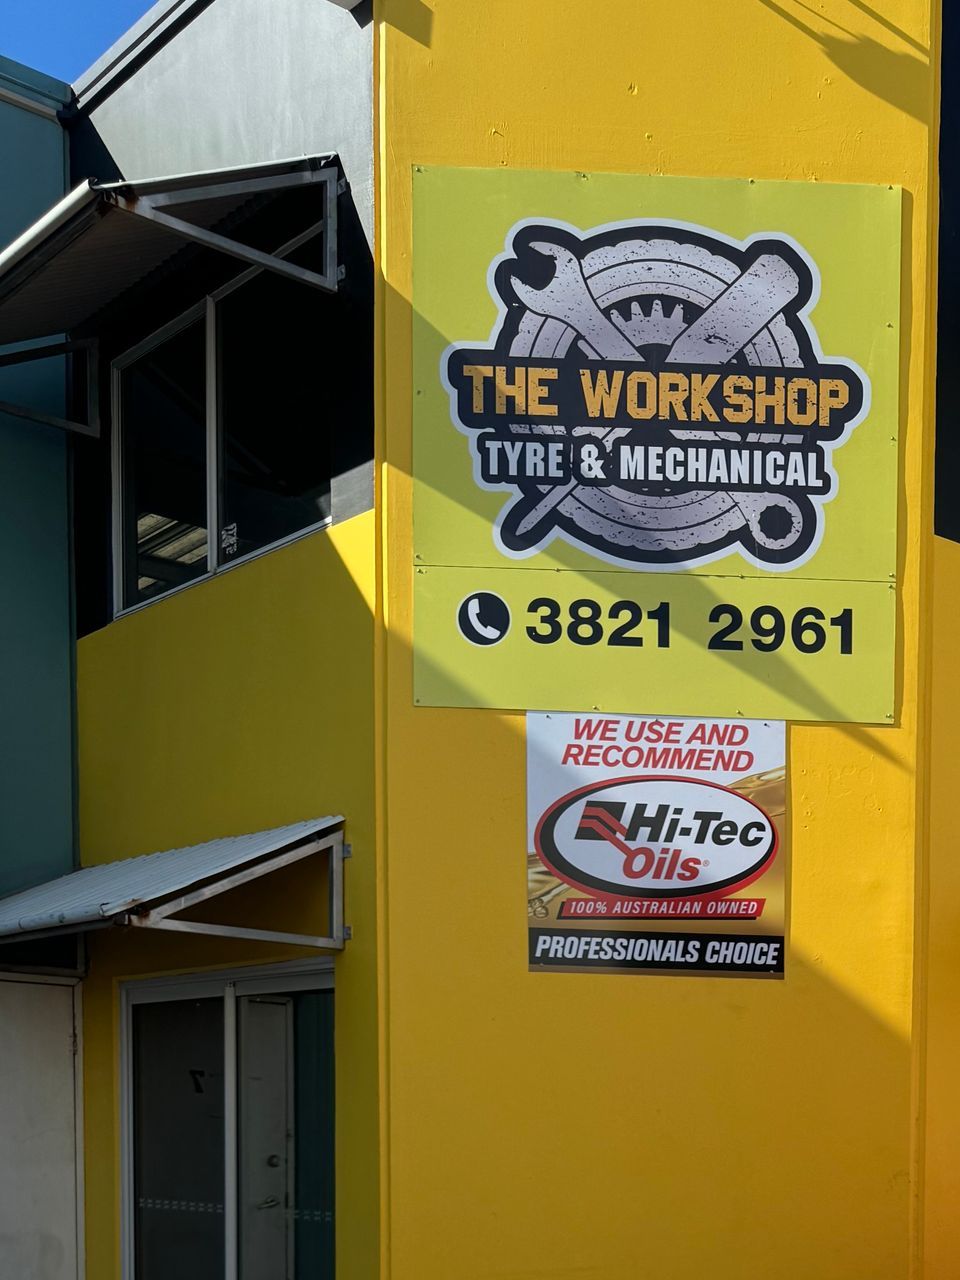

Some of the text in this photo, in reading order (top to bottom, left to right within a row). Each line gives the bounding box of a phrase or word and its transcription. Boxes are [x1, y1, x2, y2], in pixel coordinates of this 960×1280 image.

[463, 364, 850, 427] THE WORKSHOP
[484, 440, 824, 488] TYRE & MECHANICAL
[525, 597, 854, 655] 3821 2961
[573, 718, 750, 746] WE USE AND
[561, 743, 754, 772] RECOMMEND
[624, 802, 766, 847] Hi-Tec
[570, 901, 759, 915] 100% AUSTRALIAN OWNED
[535, 935, 780, 965] PROFESSIONALS CHOICE
